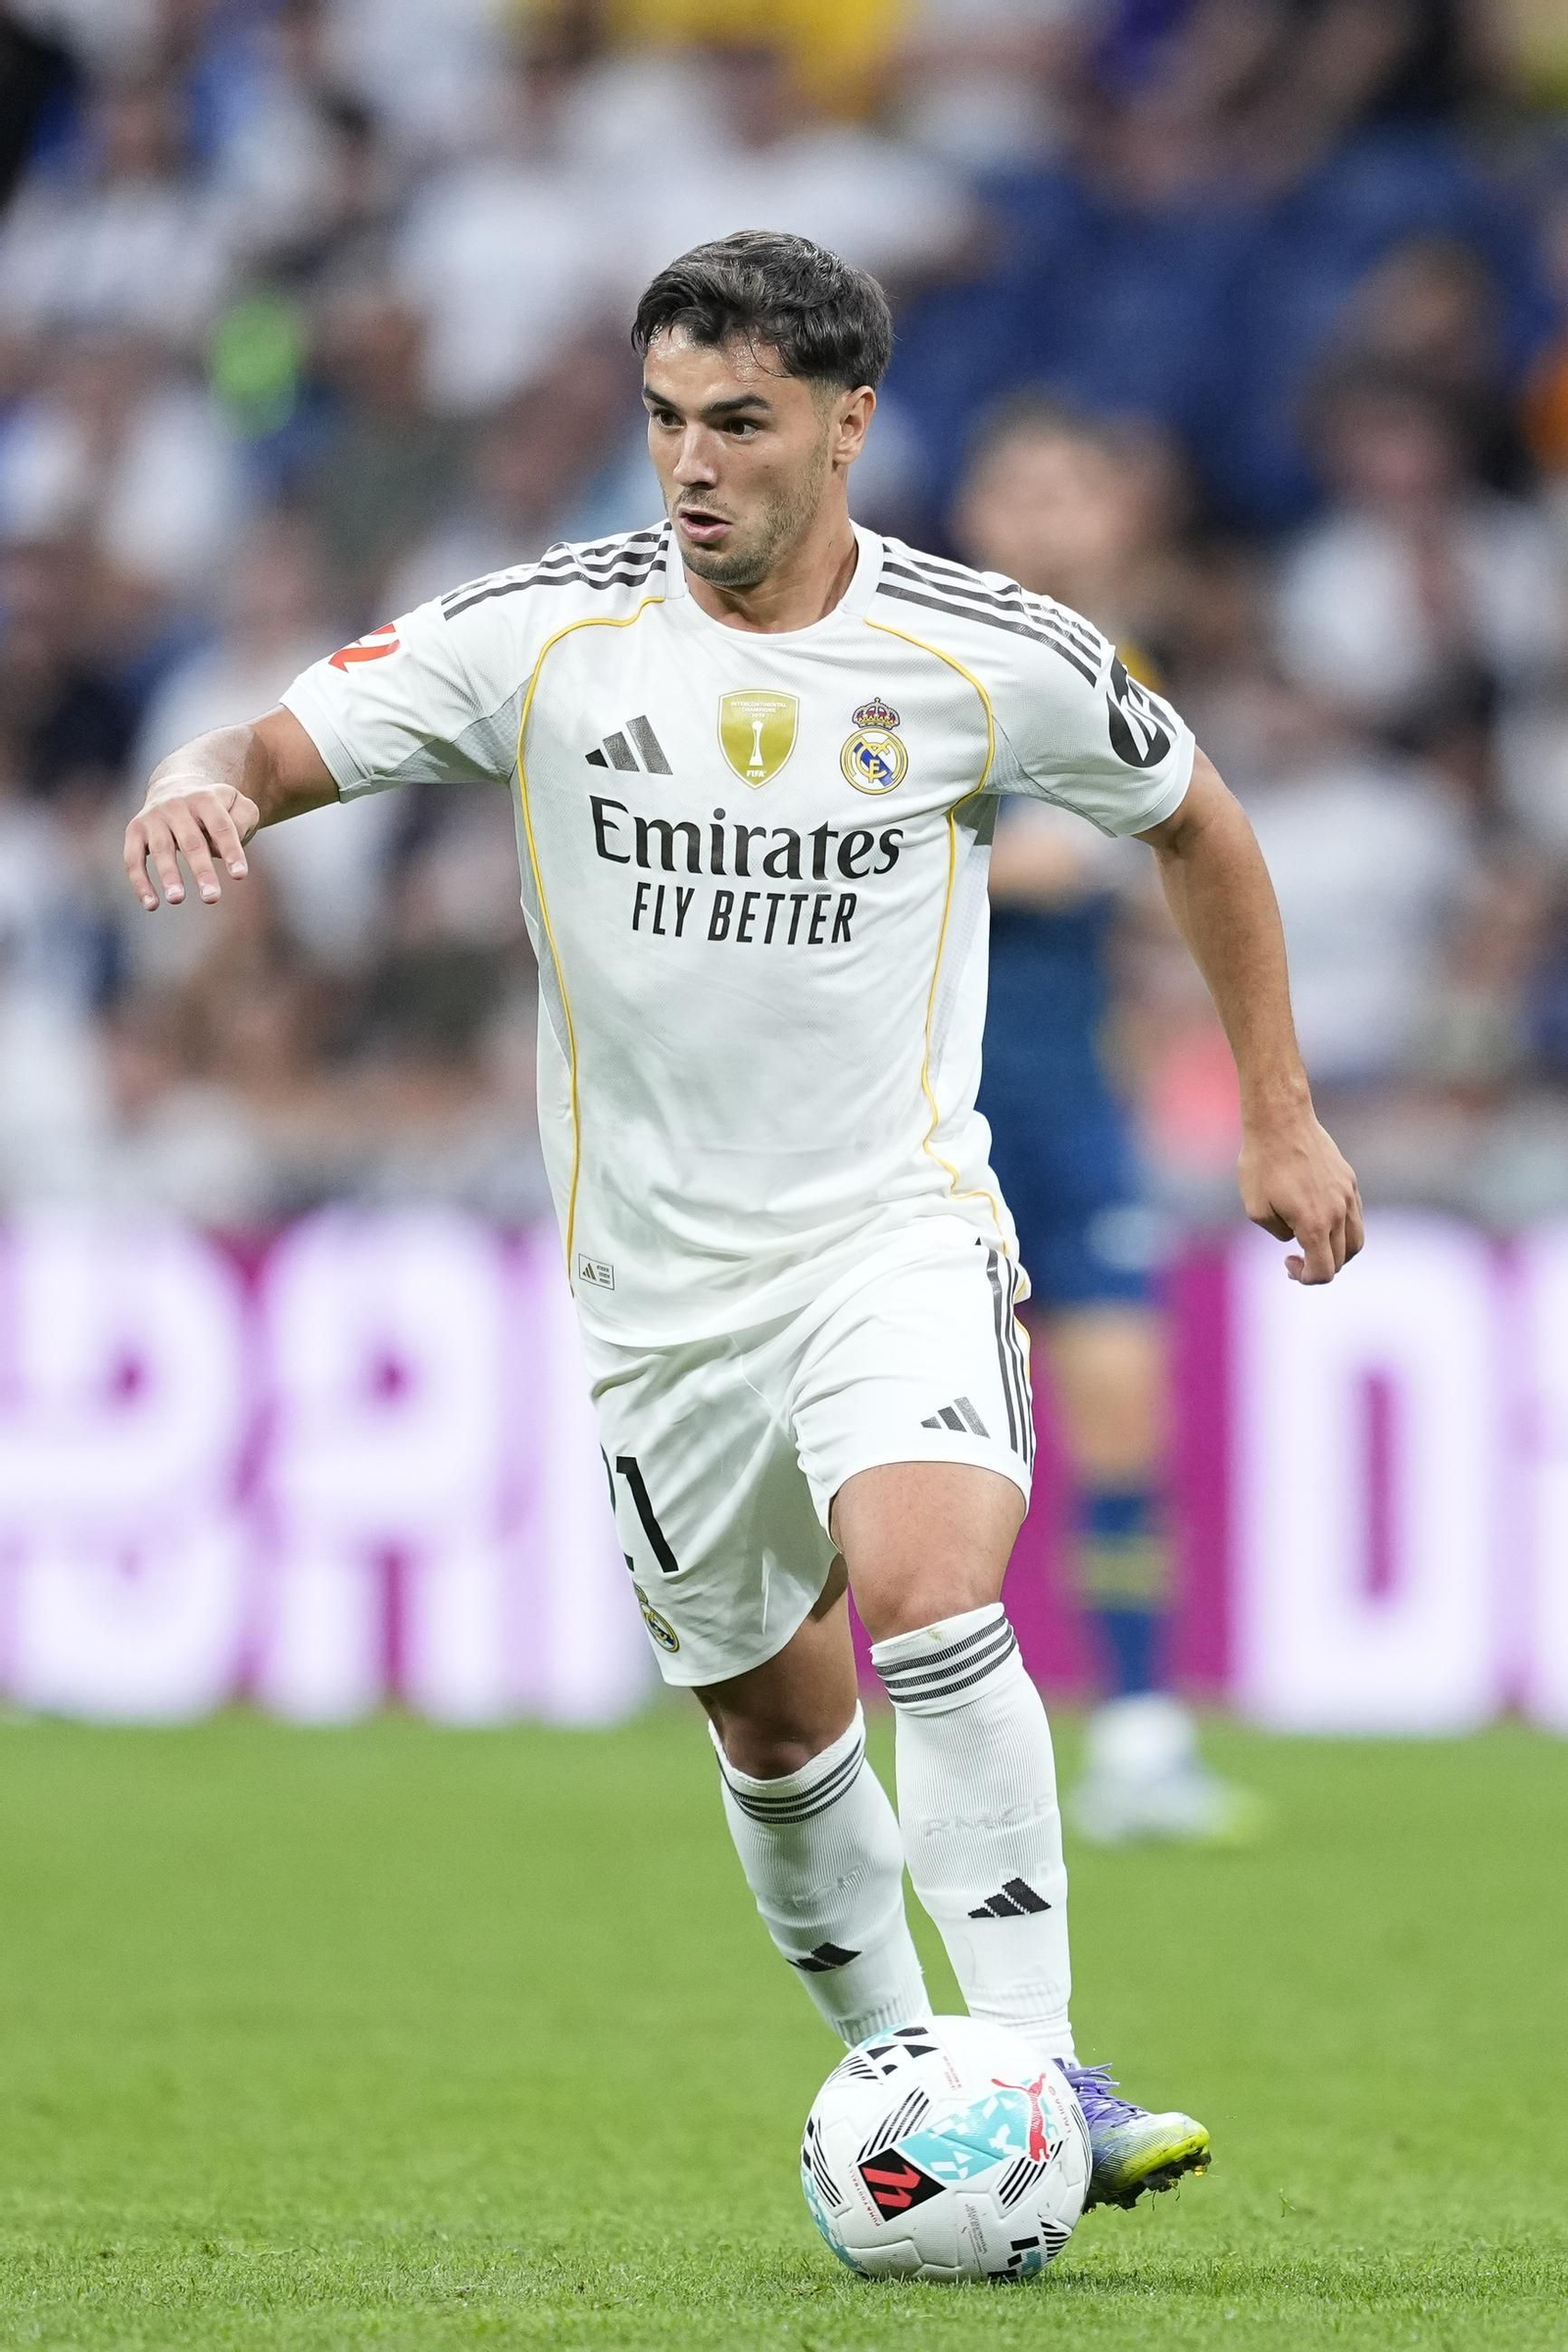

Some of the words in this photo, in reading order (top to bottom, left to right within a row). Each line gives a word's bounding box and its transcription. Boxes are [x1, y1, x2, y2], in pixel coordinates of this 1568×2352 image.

[590, 795, 904, 880] Emirates
[632, 881, 695, 938] FLY
[708, 890, 858, 945] BETTER
